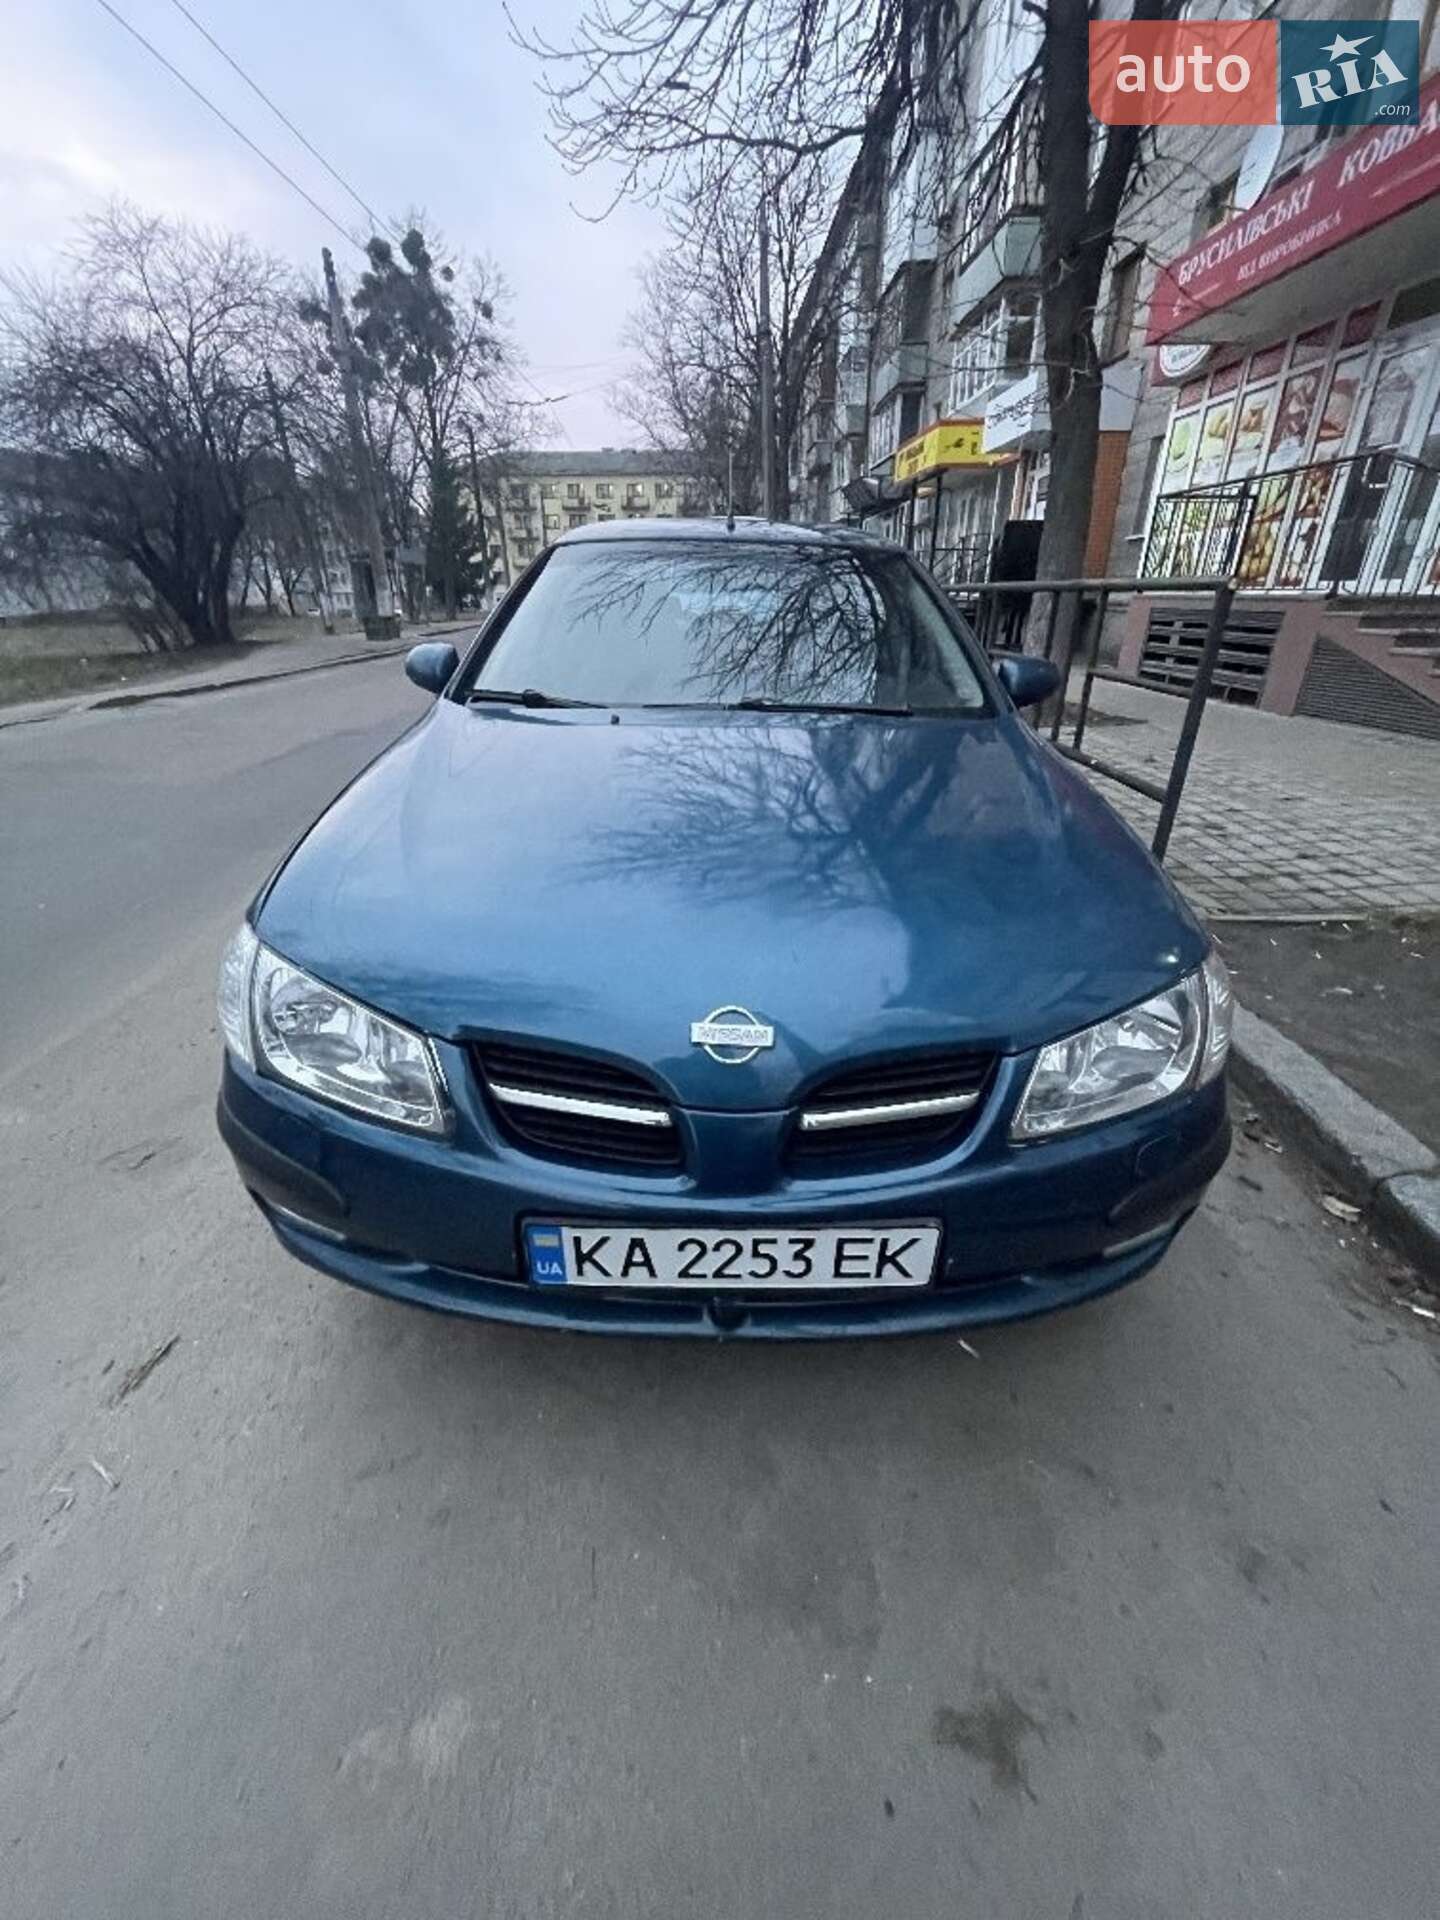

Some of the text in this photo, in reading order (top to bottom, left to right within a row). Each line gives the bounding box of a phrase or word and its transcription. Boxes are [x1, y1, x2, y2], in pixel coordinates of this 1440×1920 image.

[1336, 98, 1440, 190] КОВБА
[537, 1261, 563, 1275] UA
[573, 1236, 923, 1280] KA 2253 EK
